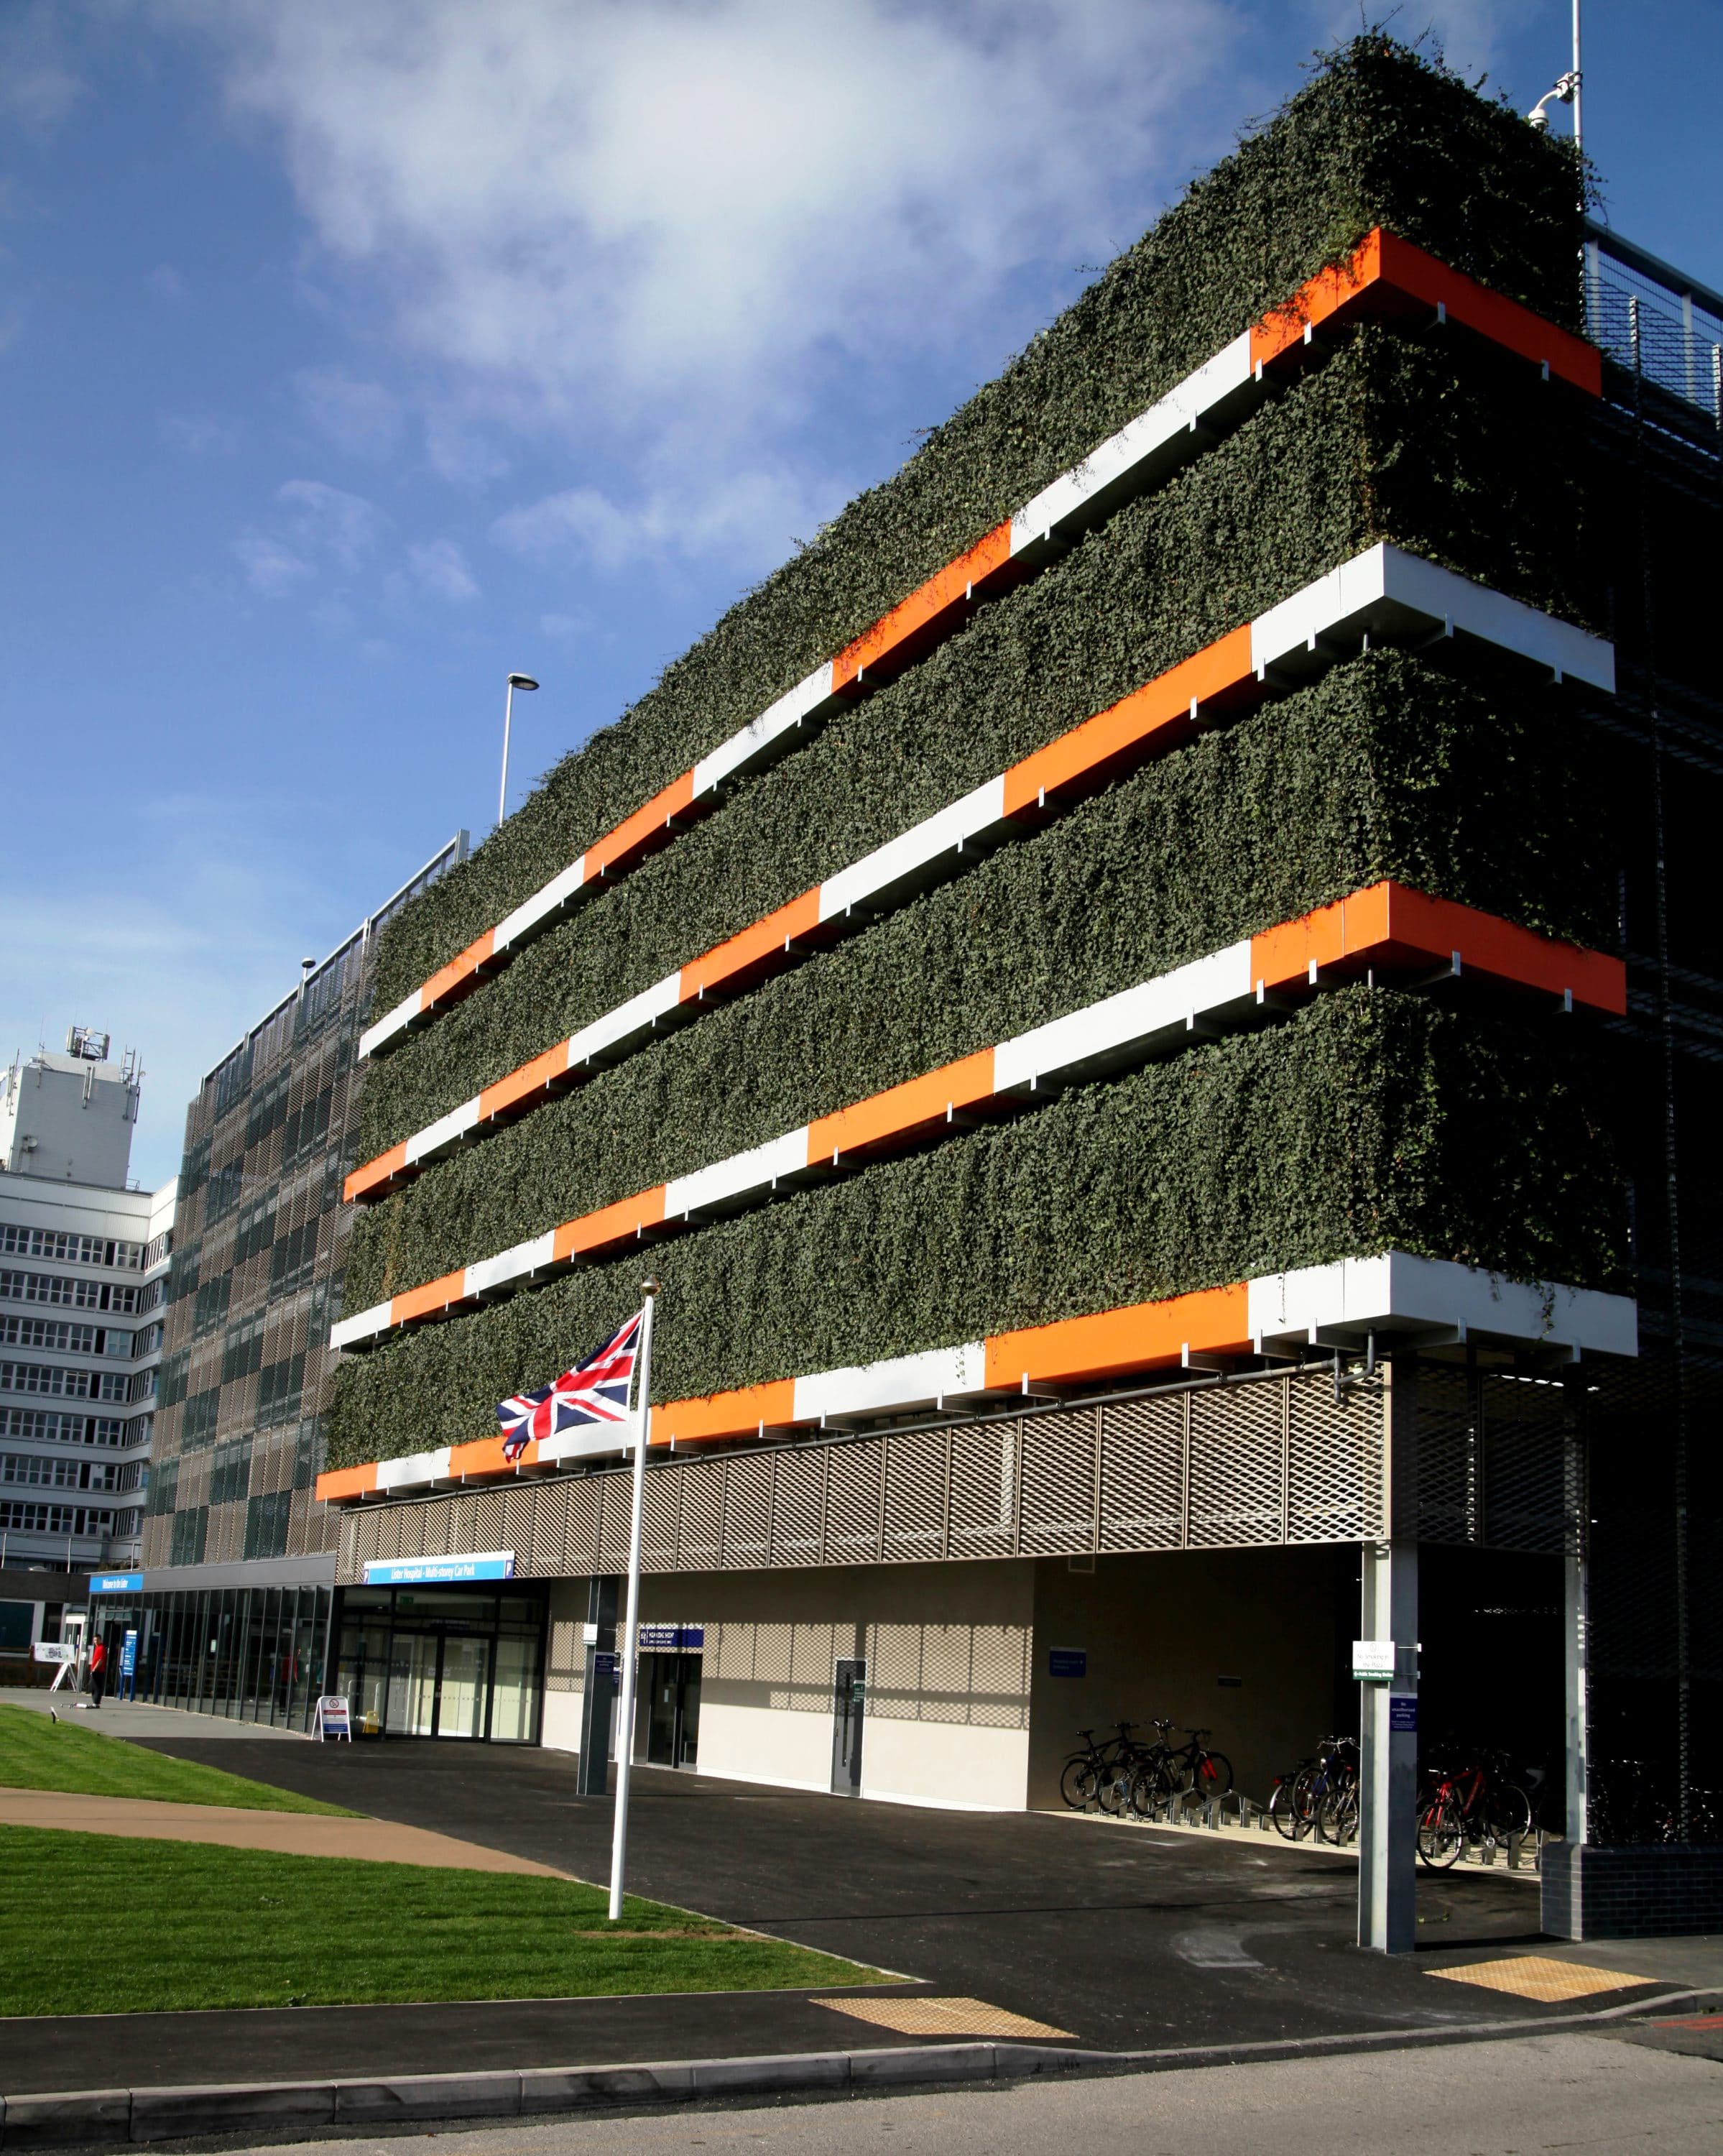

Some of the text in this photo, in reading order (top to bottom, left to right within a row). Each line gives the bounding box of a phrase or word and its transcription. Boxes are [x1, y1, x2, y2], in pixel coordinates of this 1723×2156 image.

[391, 1568, 403, 1580] Lister
[404, 1566, 422, 1581] Hospital
[425, 1565, 454, 1580] Multi-storey
[454, 1565, 463, 1576] Car
[463, 1564, 475, 1575] Park
[507, 1562, 512, 1576] P
[364, 1571, 368, 1583] P
